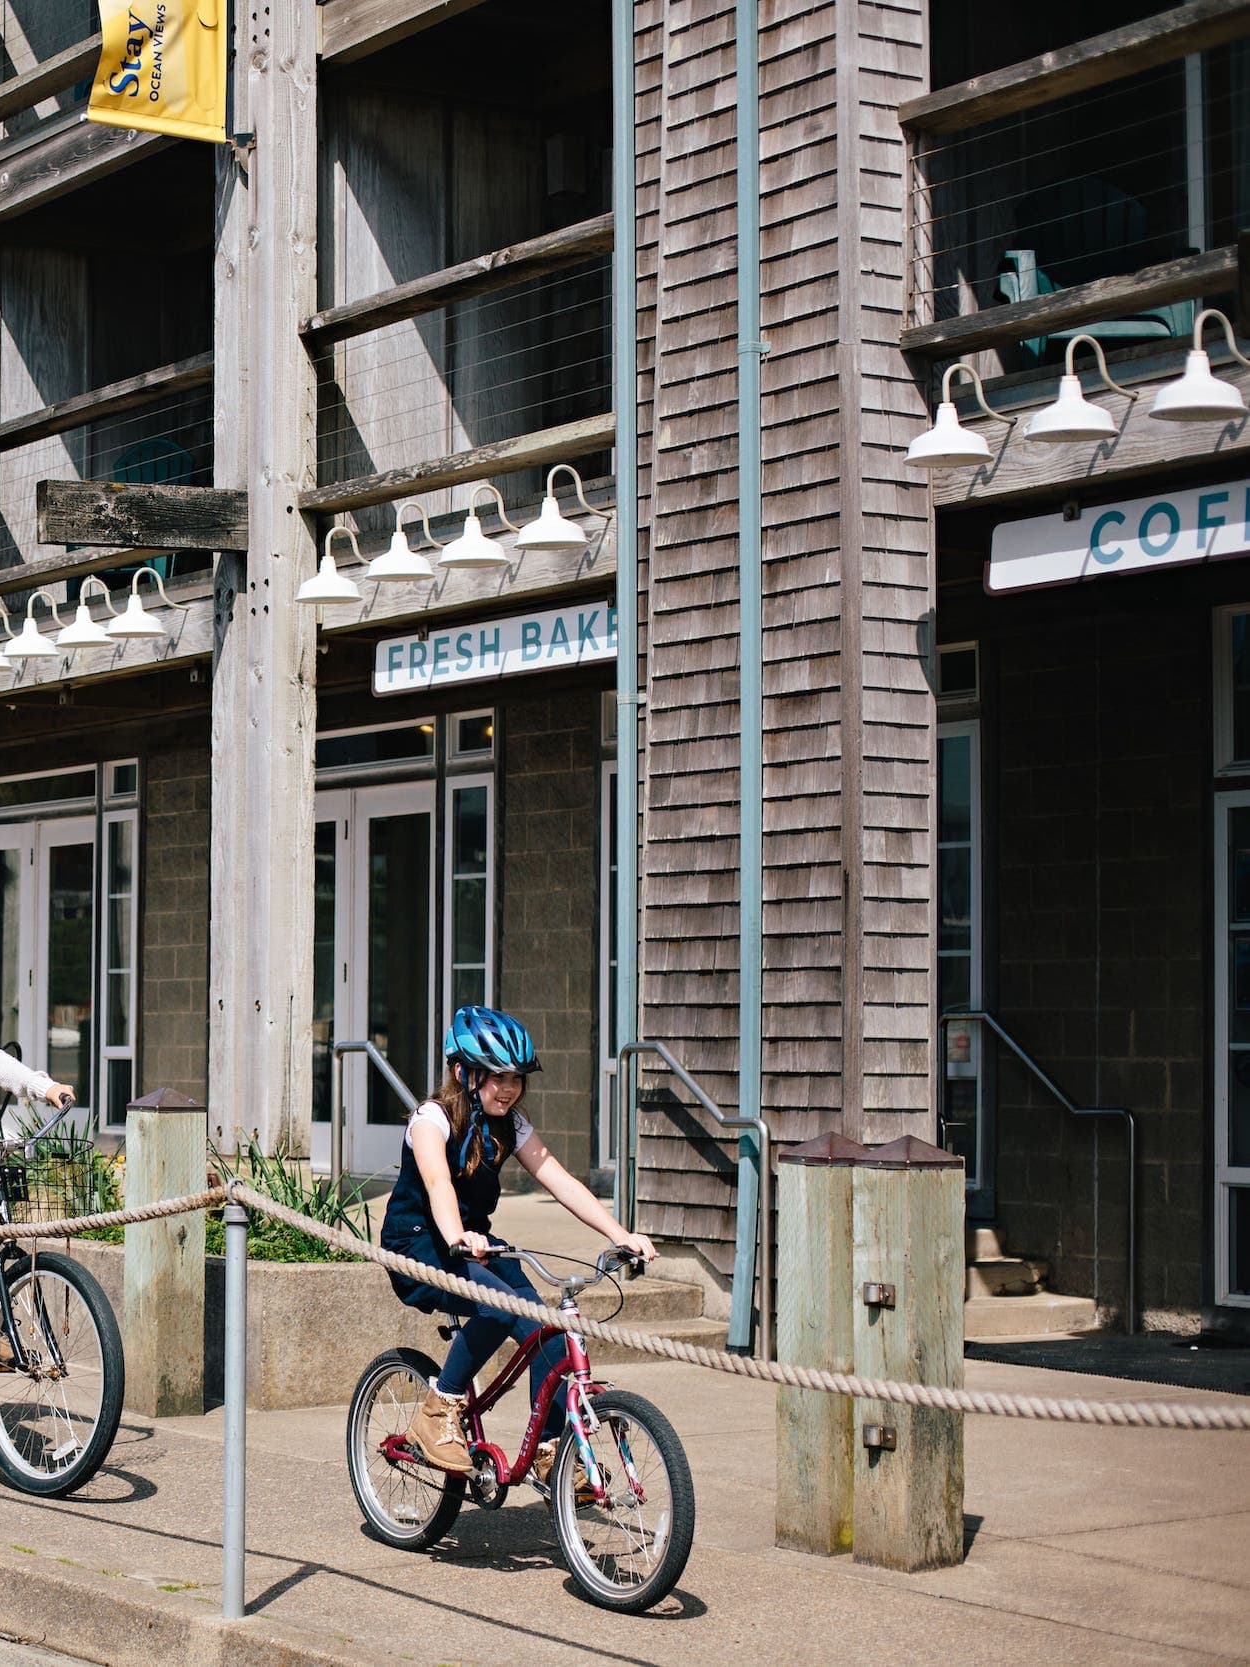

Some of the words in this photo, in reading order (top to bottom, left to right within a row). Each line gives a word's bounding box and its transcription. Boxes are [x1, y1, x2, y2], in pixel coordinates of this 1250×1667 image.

[109, 9, 154, 97] Stay
[153, 4, 166, 48] VIEWS
[149, 51, 163, 102] OCEAN
[1090, 487, 1250, 565] COF
[387, 628, 500, 683] FRESH
[521, 608, 618, 662] BAKE
